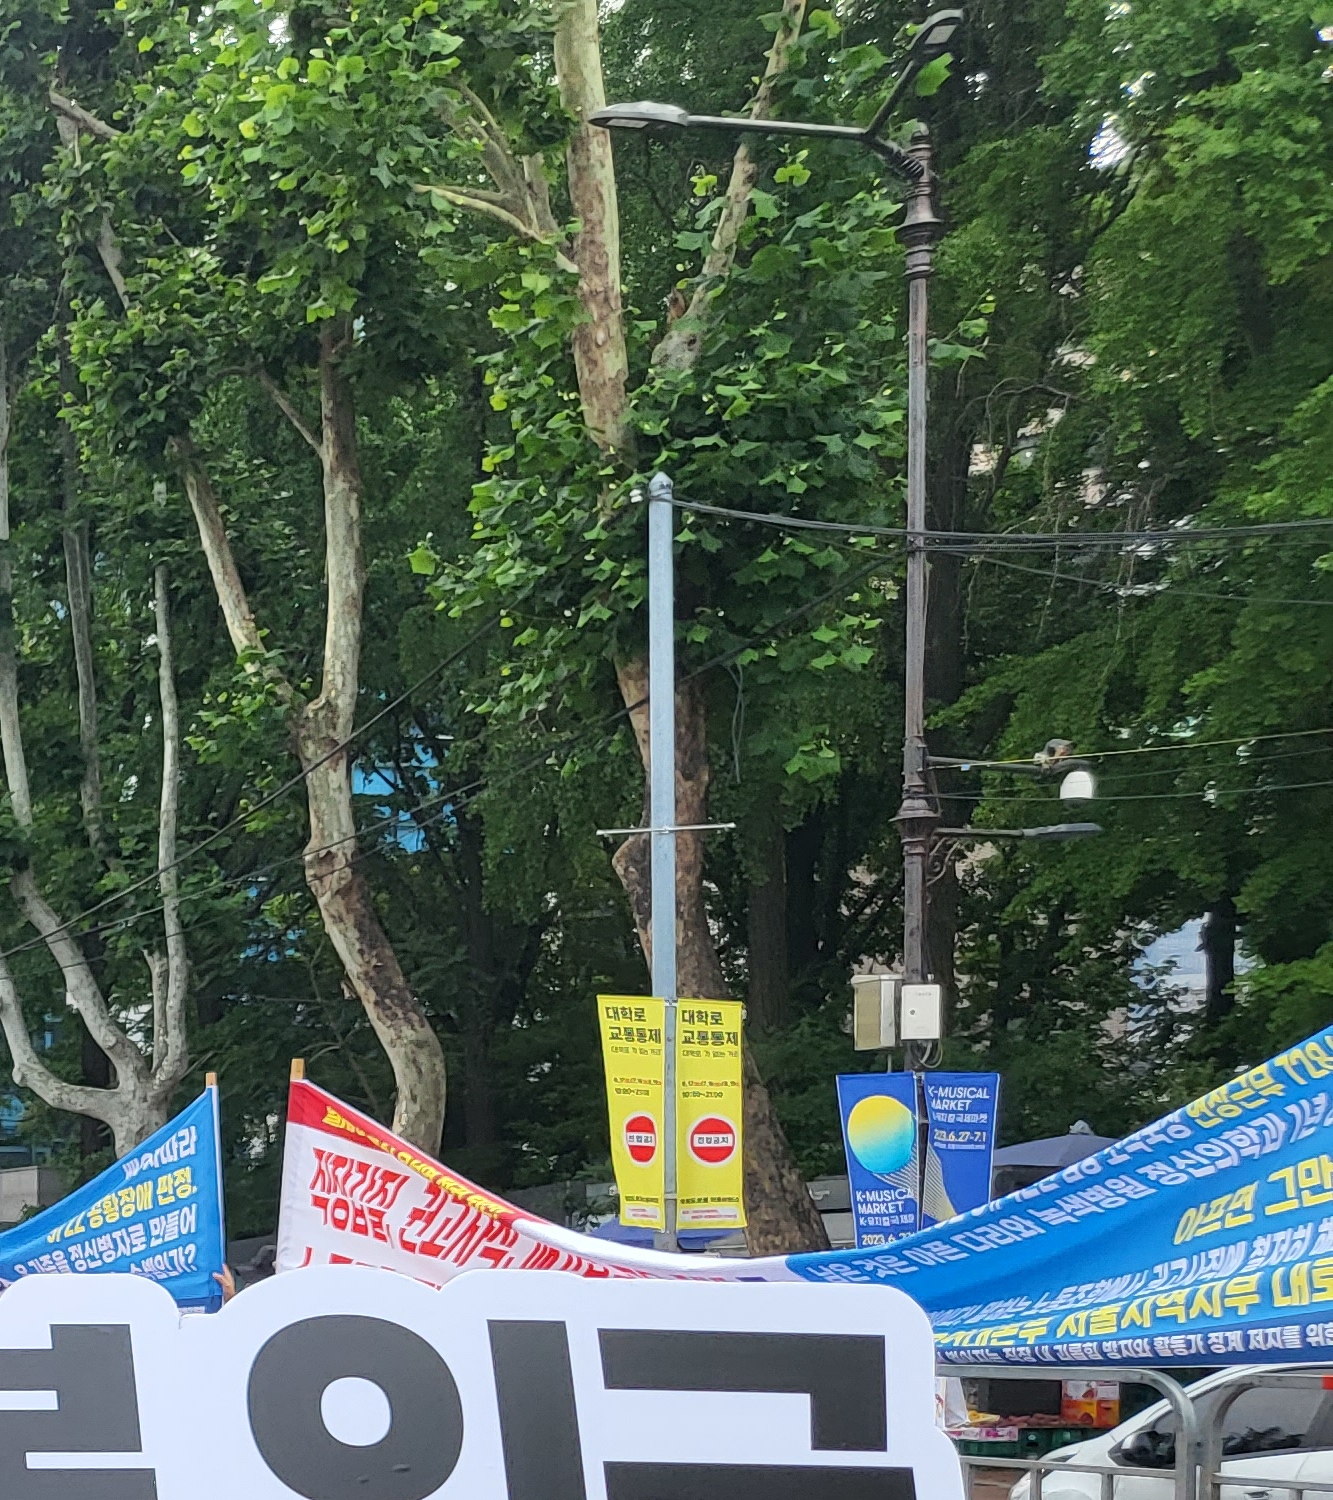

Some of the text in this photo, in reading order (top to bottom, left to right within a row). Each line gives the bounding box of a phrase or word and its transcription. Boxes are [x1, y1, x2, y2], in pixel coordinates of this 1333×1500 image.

[605, 1006, 646, 1022] 대학로
[681, 1009, 724, 1026] 대학로
[609, 1026, 661, 1043] 교통통제
[681, 1029, 739, 1046] 교통통제
[856, 1189, 916, 1203] K-MUSICA
[901, 1240, 971, 1266] 아픈
[950, 1214, 1046, 1252] 다리와
[1027, 1174, 1158, 1226] 녹색병원
[1136, 1112, 1287, 1186] 정신의학과
[85, 1181, 154, 1230] 공황장애
[858, 1201, 905, 1215] MARKET
[1173, 1180, 1260, 1246] 아프면
[67, 1222, 148, 1273] 정신병자로
[149, 1203, 198, 1248] 만들어
[1244, 1221, 1315, 1272] 철저히
[1102, 1337, 1151, 1361] 방지와
[1151, 1332, 1206, 1358] 활동가
[1207, 1328, 1244, 1353] 징계
[1246, 1324, 1303, 1352] 저지를
